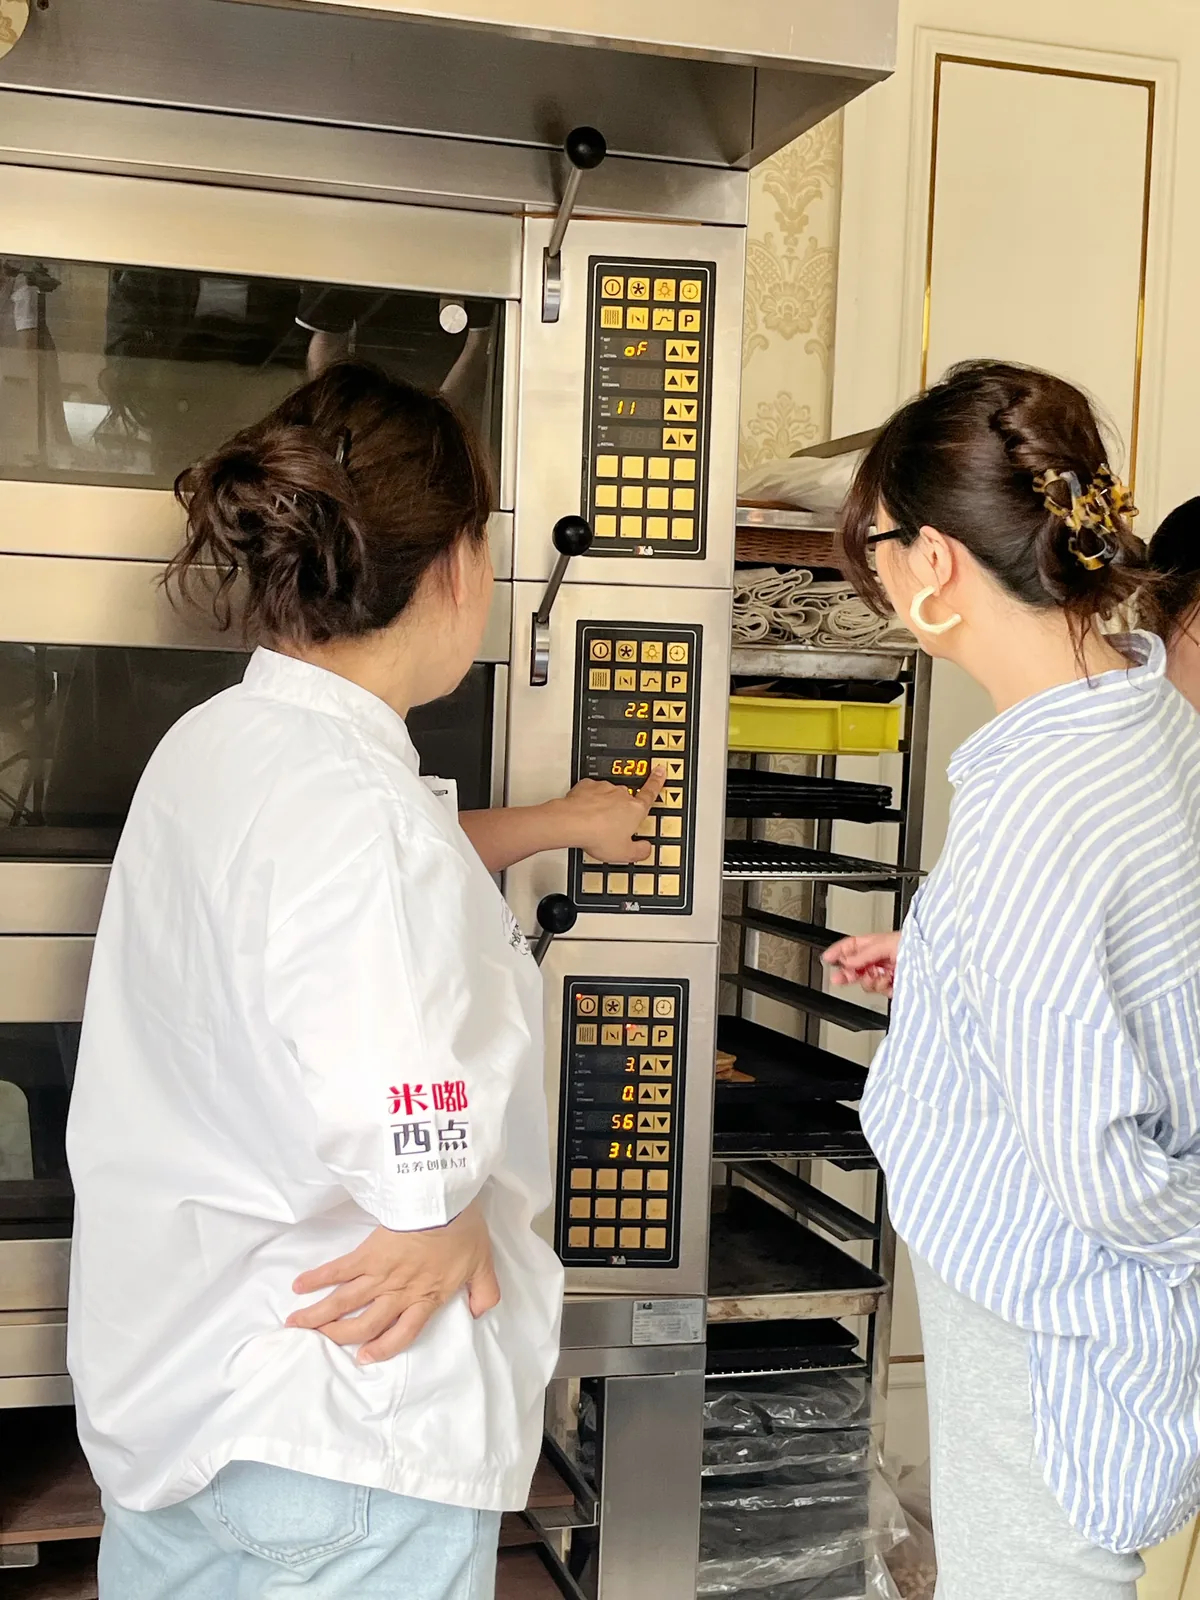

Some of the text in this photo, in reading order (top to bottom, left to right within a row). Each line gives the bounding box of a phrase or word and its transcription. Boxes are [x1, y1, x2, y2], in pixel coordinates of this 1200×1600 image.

[684, 315, 694, 327] P
[617, 400, 635, 415] 11
[671, 676, 682, 688] P
[635, 731, 647, 747] 0
[658, 1030, 668, 1042] P
[386, 1080, 469, 1116] 米嘟
[390, 1119, 469, 1156] 西点
